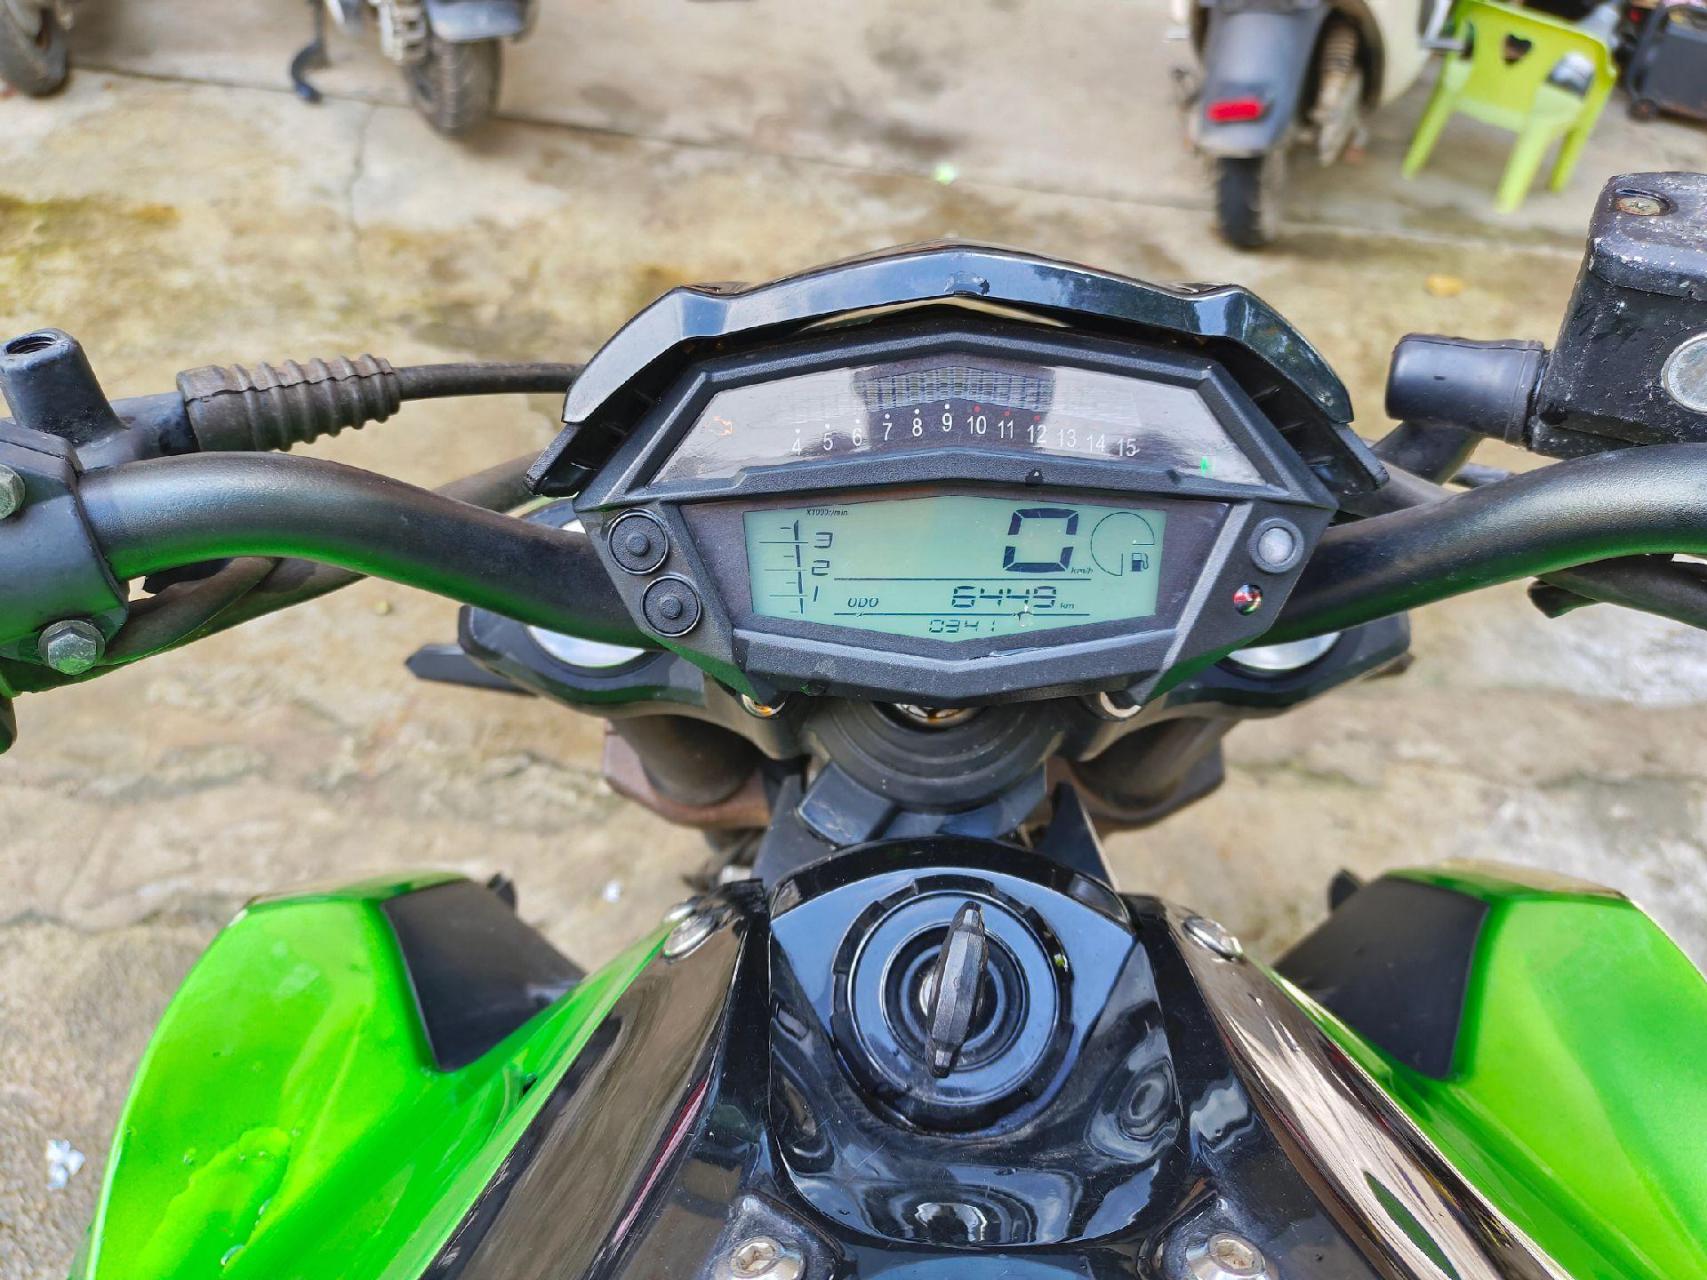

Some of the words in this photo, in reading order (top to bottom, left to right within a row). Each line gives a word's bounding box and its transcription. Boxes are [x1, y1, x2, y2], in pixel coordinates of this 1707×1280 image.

[823, 432, 834, 451] 5
[852, 427, 863, 447] 6
[882, 422, 893, 441] 7
[912, 417, 923, 437] 8
[942, 412, 953, 432] 9
[966, 415, 987, 435] 10
[997, 419, 1015, 439] 11
[1027, 424, 1047, 444] 12
[1057, 428, 1077, 448] 13
[1086, 433, 1106, 453] 14
[1117, 438, 1137, 457] 15
[814, 532, 833, 549] 3
[1003, 508, 1079, 573] 0
[812, 560, 830, 576] 2
[813, 586, 818, 602] 1
[952, 586, 1056, 608] 6449
